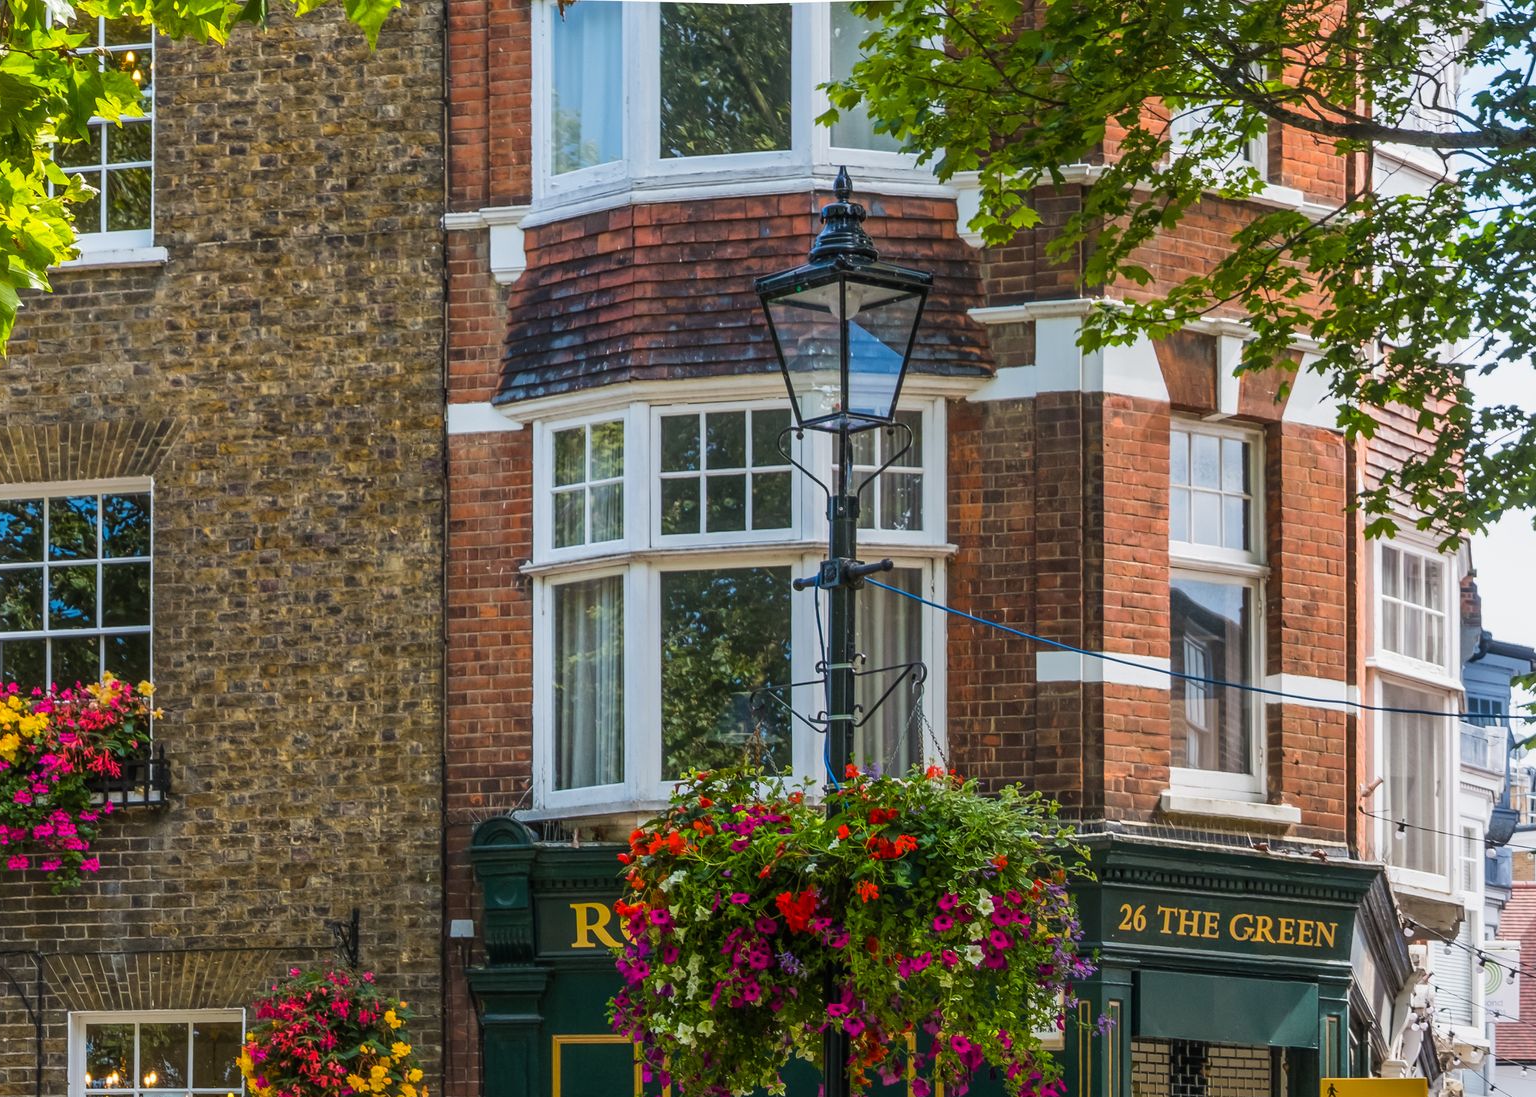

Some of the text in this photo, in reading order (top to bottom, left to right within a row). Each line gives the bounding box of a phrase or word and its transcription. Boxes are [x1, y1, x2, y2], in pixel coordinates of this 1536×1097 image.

[1118, 903, 1338, 948] 26 THE GREEN
